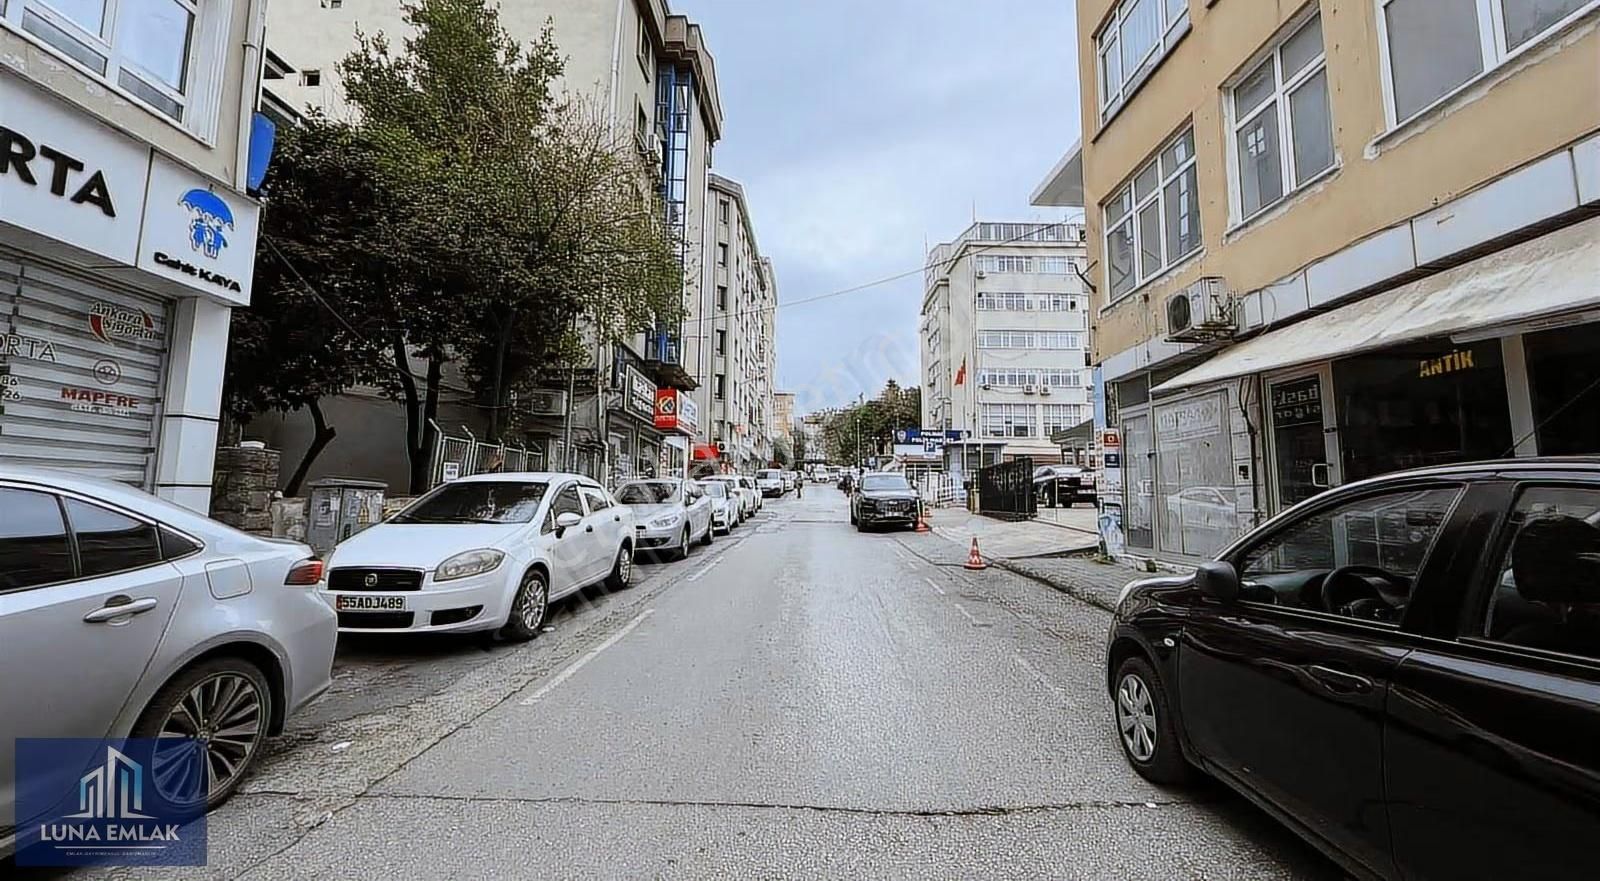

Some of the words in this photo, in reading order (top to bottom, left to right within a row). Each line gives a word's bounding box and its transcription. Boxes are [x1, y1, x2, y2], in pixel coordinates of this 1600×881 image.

[198, 267, 242, 293] KAYA
[90, 302, 144, 326] Ankara
[102, 317, 158, 341] Sigorta
[0, 334, 57, 363] RTA
[1419, 349, 1475, 378] ANTİK
[61, 387, 141, 409] MAPFRE
